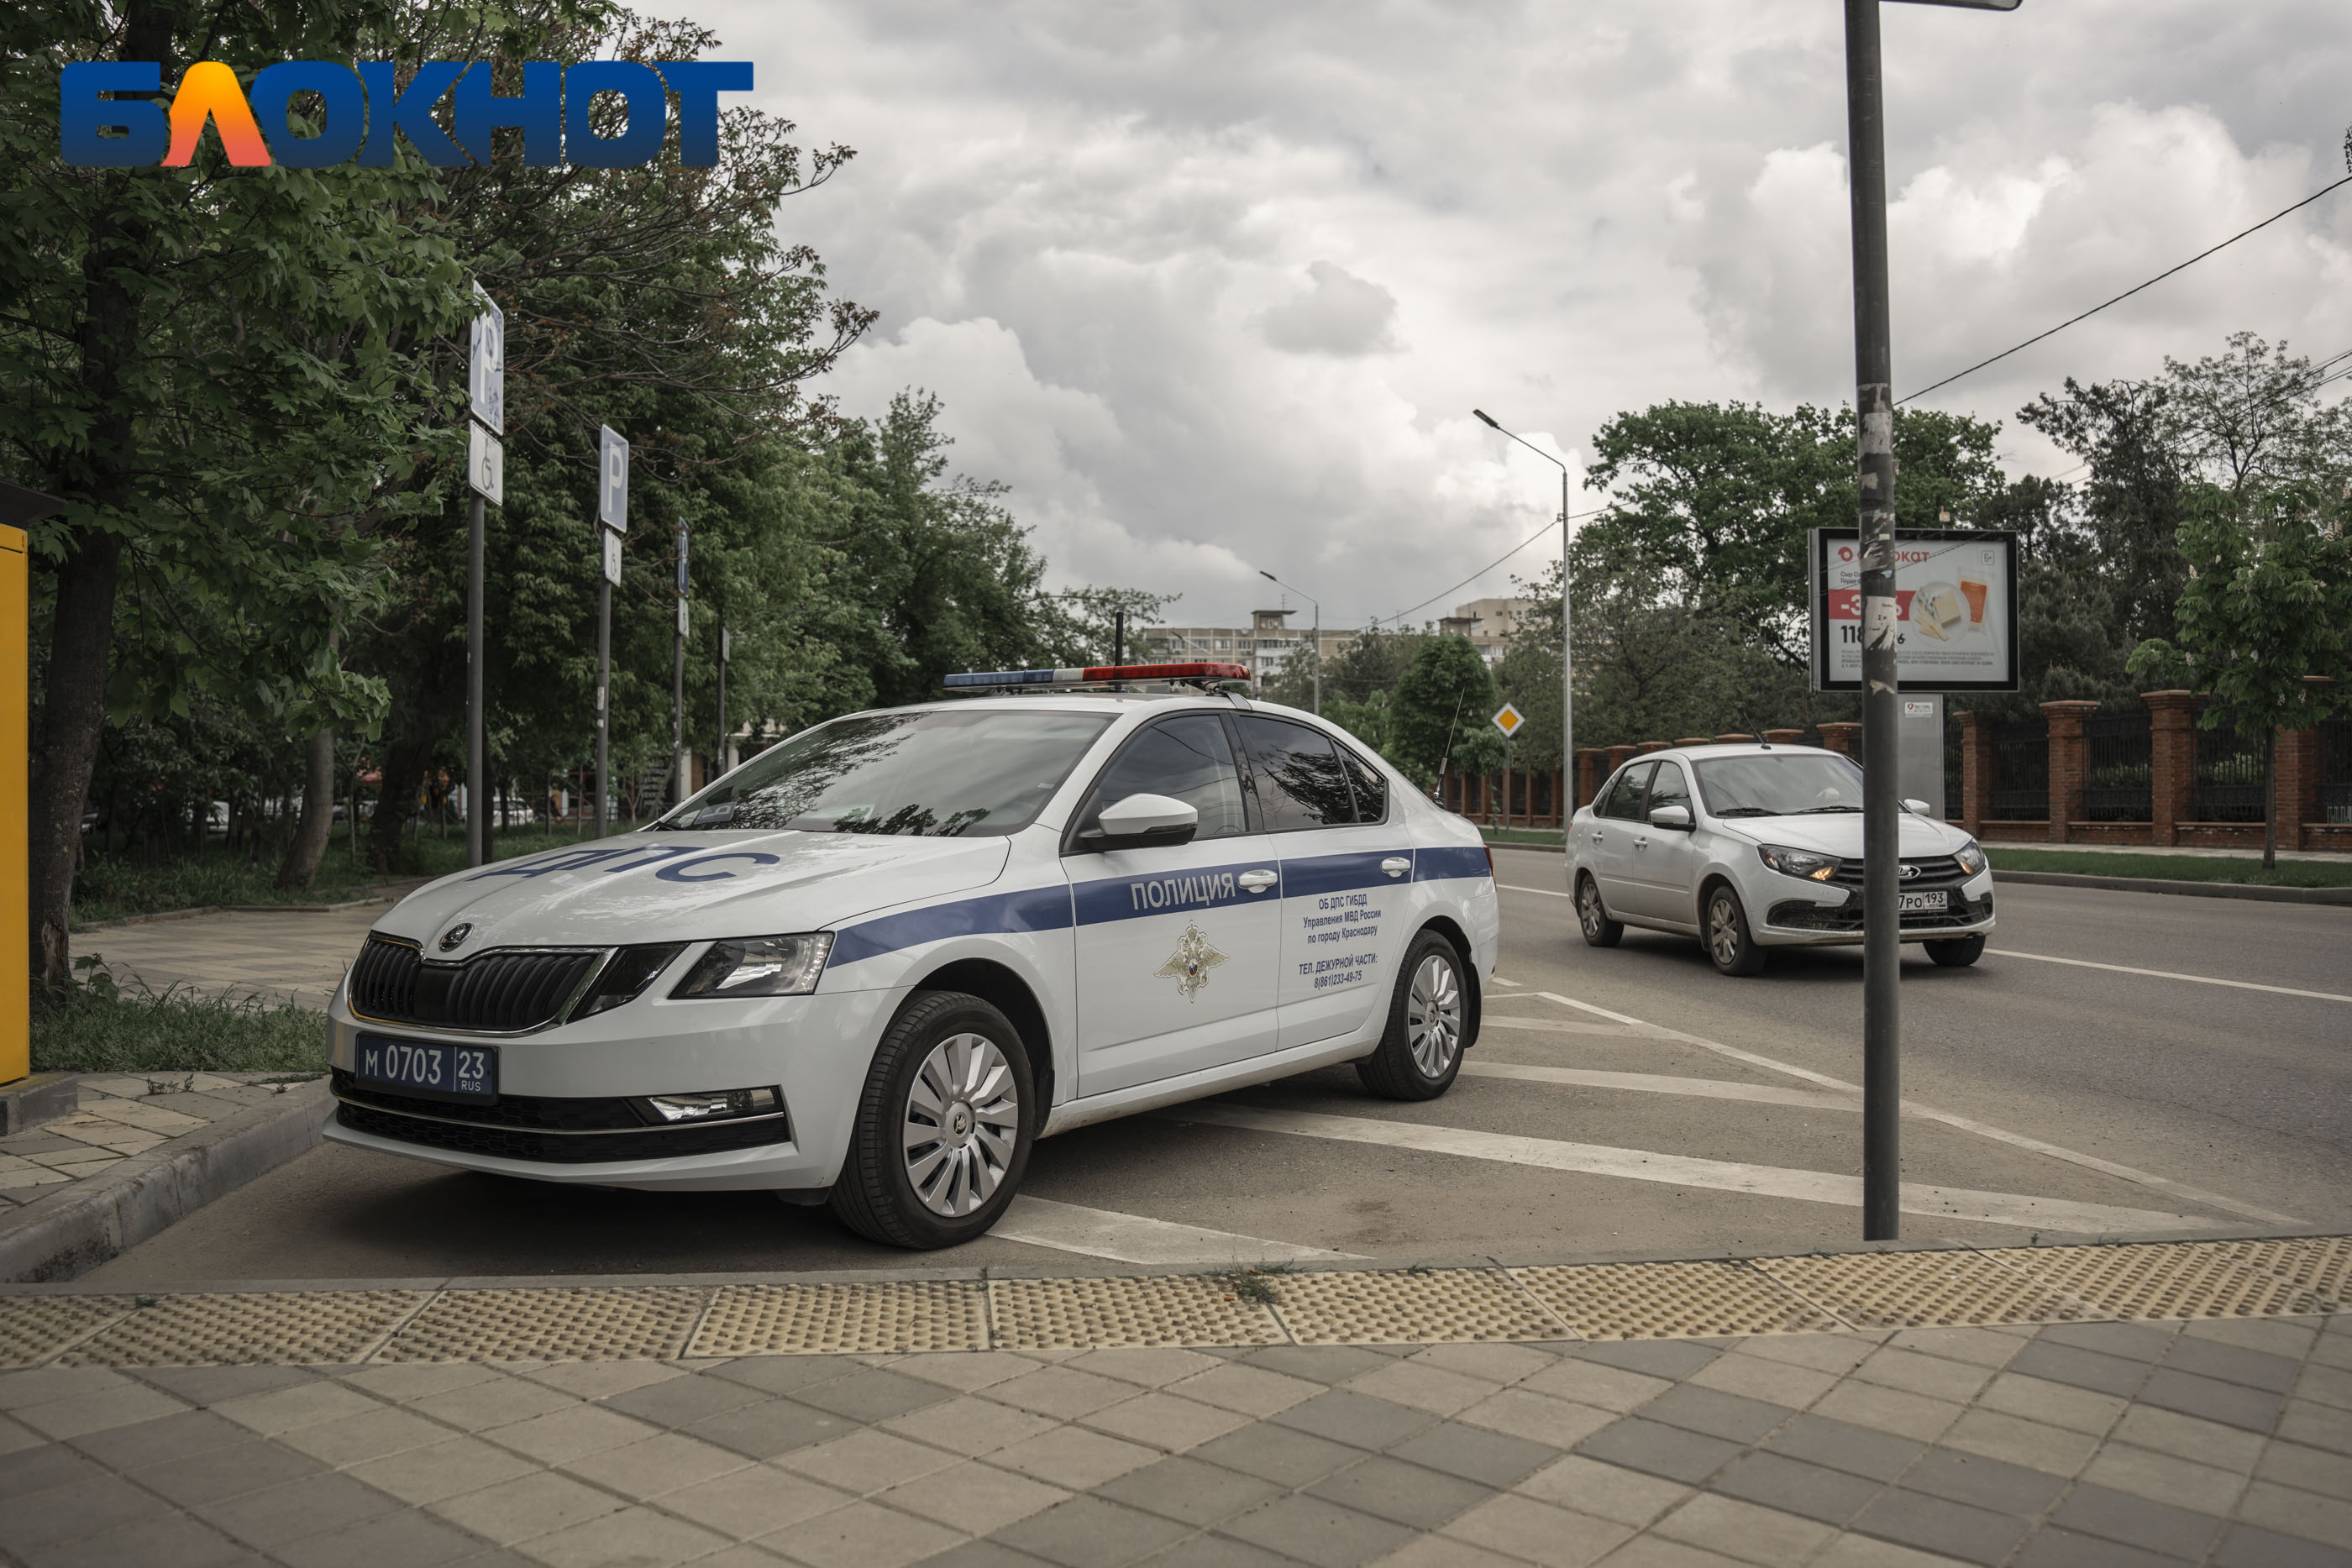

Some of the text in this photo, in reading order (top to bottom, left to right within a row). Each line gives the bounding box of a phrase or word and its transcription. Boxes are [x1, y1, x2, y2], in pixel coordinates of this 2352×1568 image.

[480, 309, 499, 404] P
[607, 442, 624, 513] P
[466, 846, 780, 883] ДПС
[1131, 873, 1236, 910] ПОЛИЦИЯ
[1319, 894, 1368, 910] ОБ ДПС ГИБДД
[1924, 892, 1944, 904] 193
[1303, 910, 1382, 930] Управления МВД России
[1307, 925, 1378, 944] по городу Краснодару
[1299, 952, 1378, 975] ТЕЛ. ДЕЖУРНОЙ ЧАСТИ:
[1314, 970, 1362, 990] 8(861)233-49-75
[365, 1045, 485, 1085] М 0703 23
[461, 1080, 481, 1092] RUS
